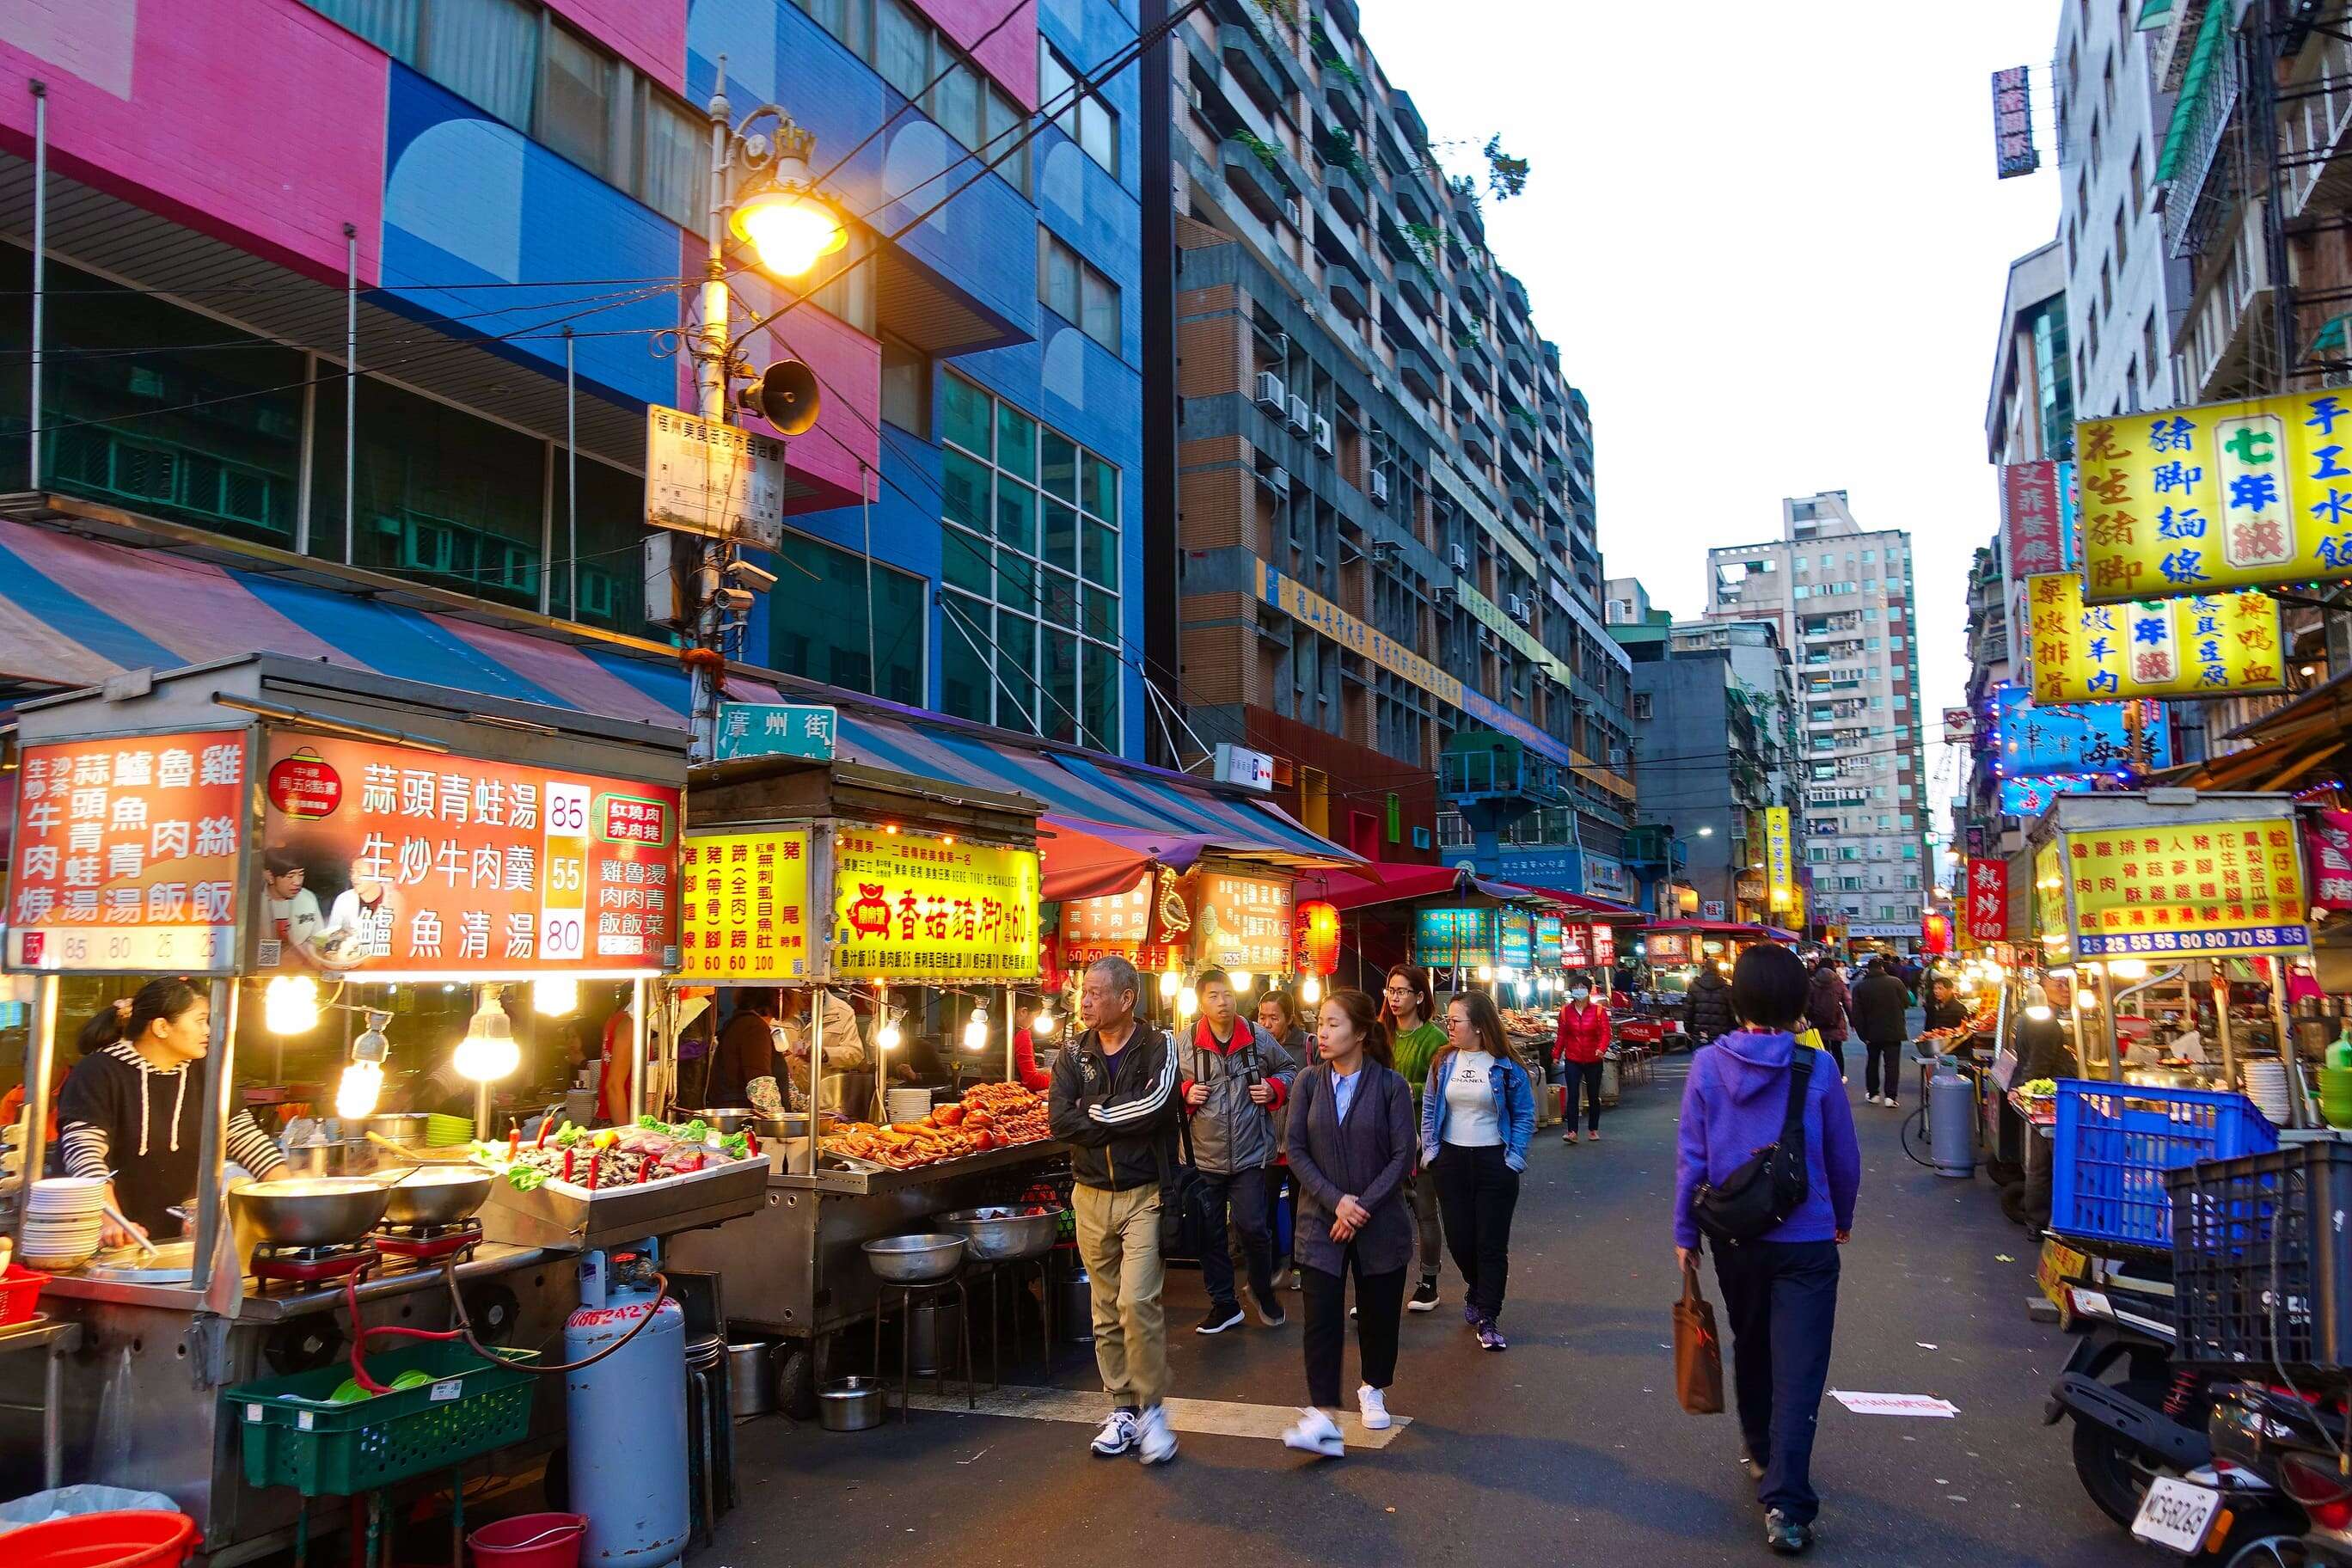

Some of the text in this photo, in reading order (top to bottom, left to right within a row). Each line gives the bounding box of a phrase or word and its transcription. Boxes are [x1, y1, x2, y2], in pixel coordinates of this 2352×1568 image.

[2225, 428, 2284, 560] 七年級
[724, 709, 829, 738] 廣州街
[363, 763, 537, 830] 蒜頭青蛙湯
[552, 796, 583, 829] 85
[61, 754, 110, 922] 蒜頭青蛙湯
[102, 751, 154, 923] 鱸魚青湯
[146, 748, 195, 922] 魯肉飯
[192, 744, 241, 922] 雞絲飯
[360, 832, 536, 891] 生炒牛肉羹
[552, 858, 579, 890] 55
[599, 860, 623, 934] 雞肉飯
[622, 861, 646, 934] 魯肉飯
[644, 863, 667, 935] 燙青菜
[358, 908, 535, 959] 鱸魚清湯
[548, 920, 579, 951] 80
[1014, 903, 1026, 943] 60
[1973, 922, 2002, 938] 100
[2081, 927, 2304, 953] 25 25 55 55 80 90 70 55 55
[64, 938, 86, 959] 85
[109, 937, 131, 959] 80
[157, 934, 173, 957] 25
[200, 934, 217, 957] 25
[704, 956, 720, 971] 60
[730, 955, 746, 971] 60
[755, 956, 773, 971] 100
[1069, 951, 1082, 963] 60
[1088, 950, 1103, 962] 60
[1130, 952, 1144, 964] 25
